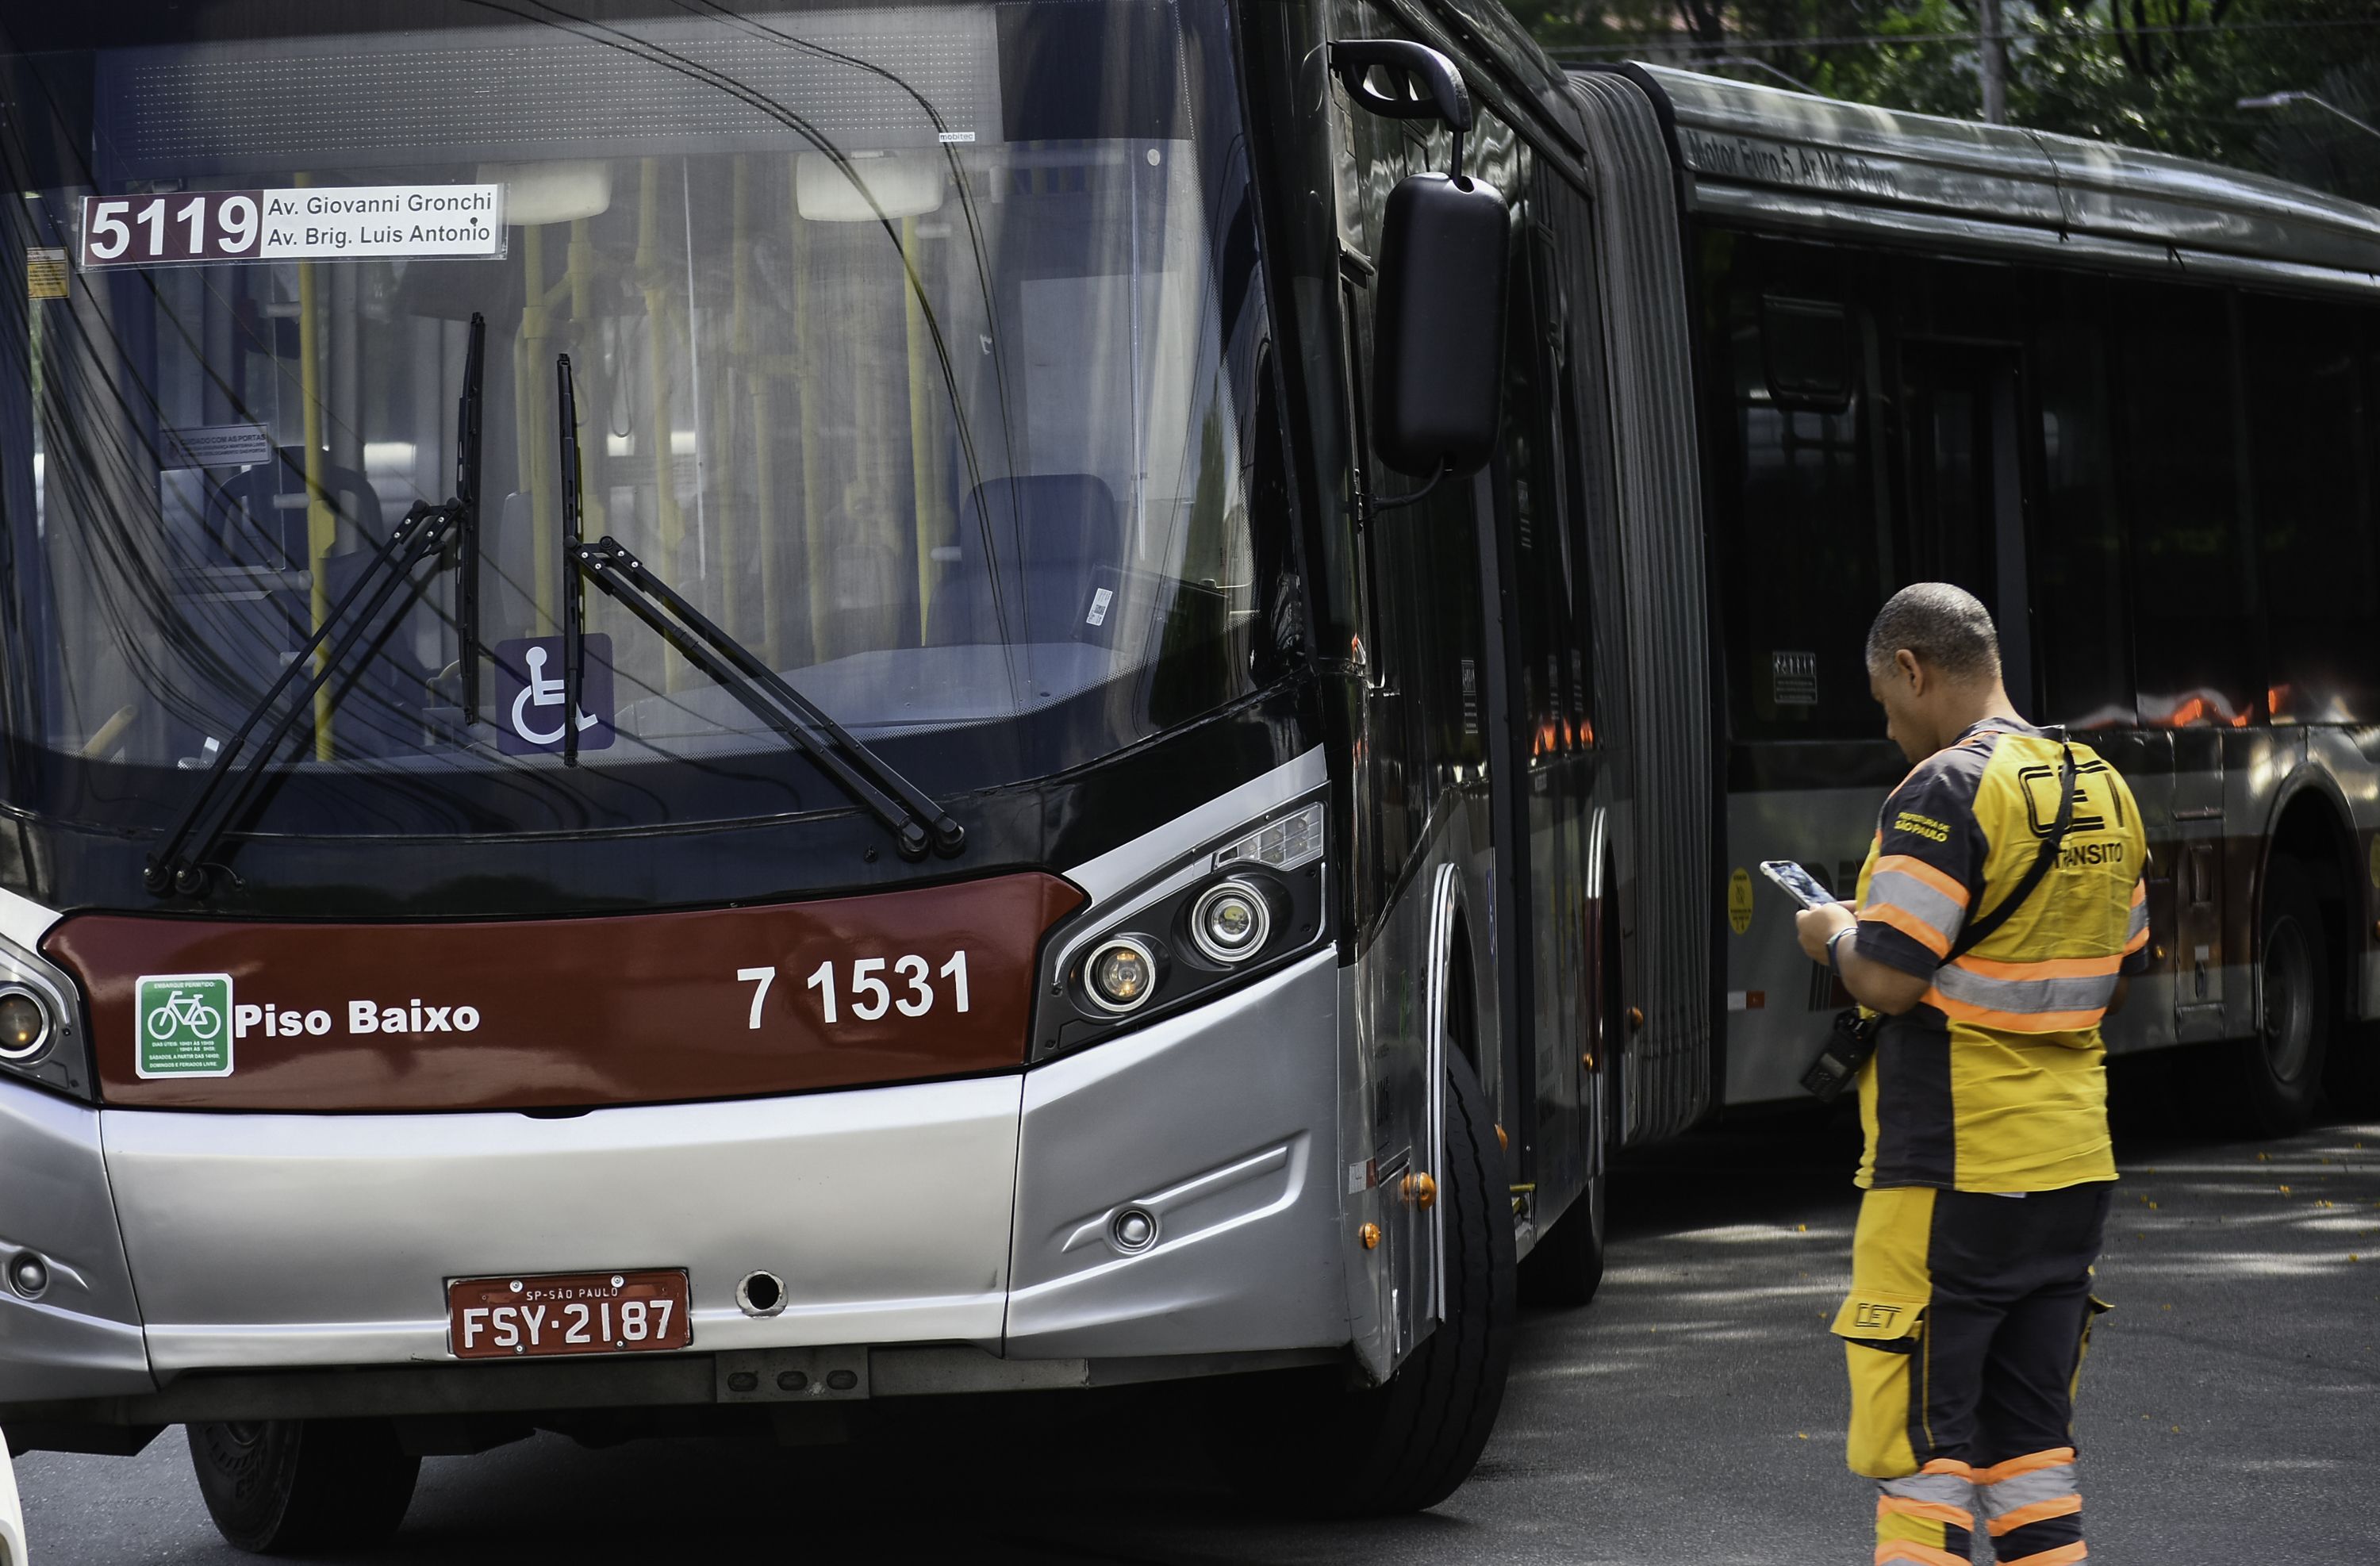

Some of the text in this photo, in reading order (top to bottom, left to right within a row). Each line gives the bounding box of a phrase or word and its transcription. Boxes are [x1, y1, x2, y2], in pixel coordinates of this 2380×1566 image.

[1686, 130, 1738, 173] Motor
[1737, 137, 1783, 181] Euro
[1797, 148, 1818, 184] Ar
[268, 192, 492, 215] Av. Giovanni Gronchi
[90, 195, 259, 259] 5119
[267, 221, 490, 248] Av. Brig. Luis Antonio
[238, 433, 266, 442] PORTAS
[1911, 823, 1948, 842] PAULO
[737, 950, 969, 1029] 7 1531
[235, 999, 480, 1038] Piso Baixo
[526, 1287, 618, 1301] SP-SÃO PAULO
[1854, 1303, 1902, 1329] CET
